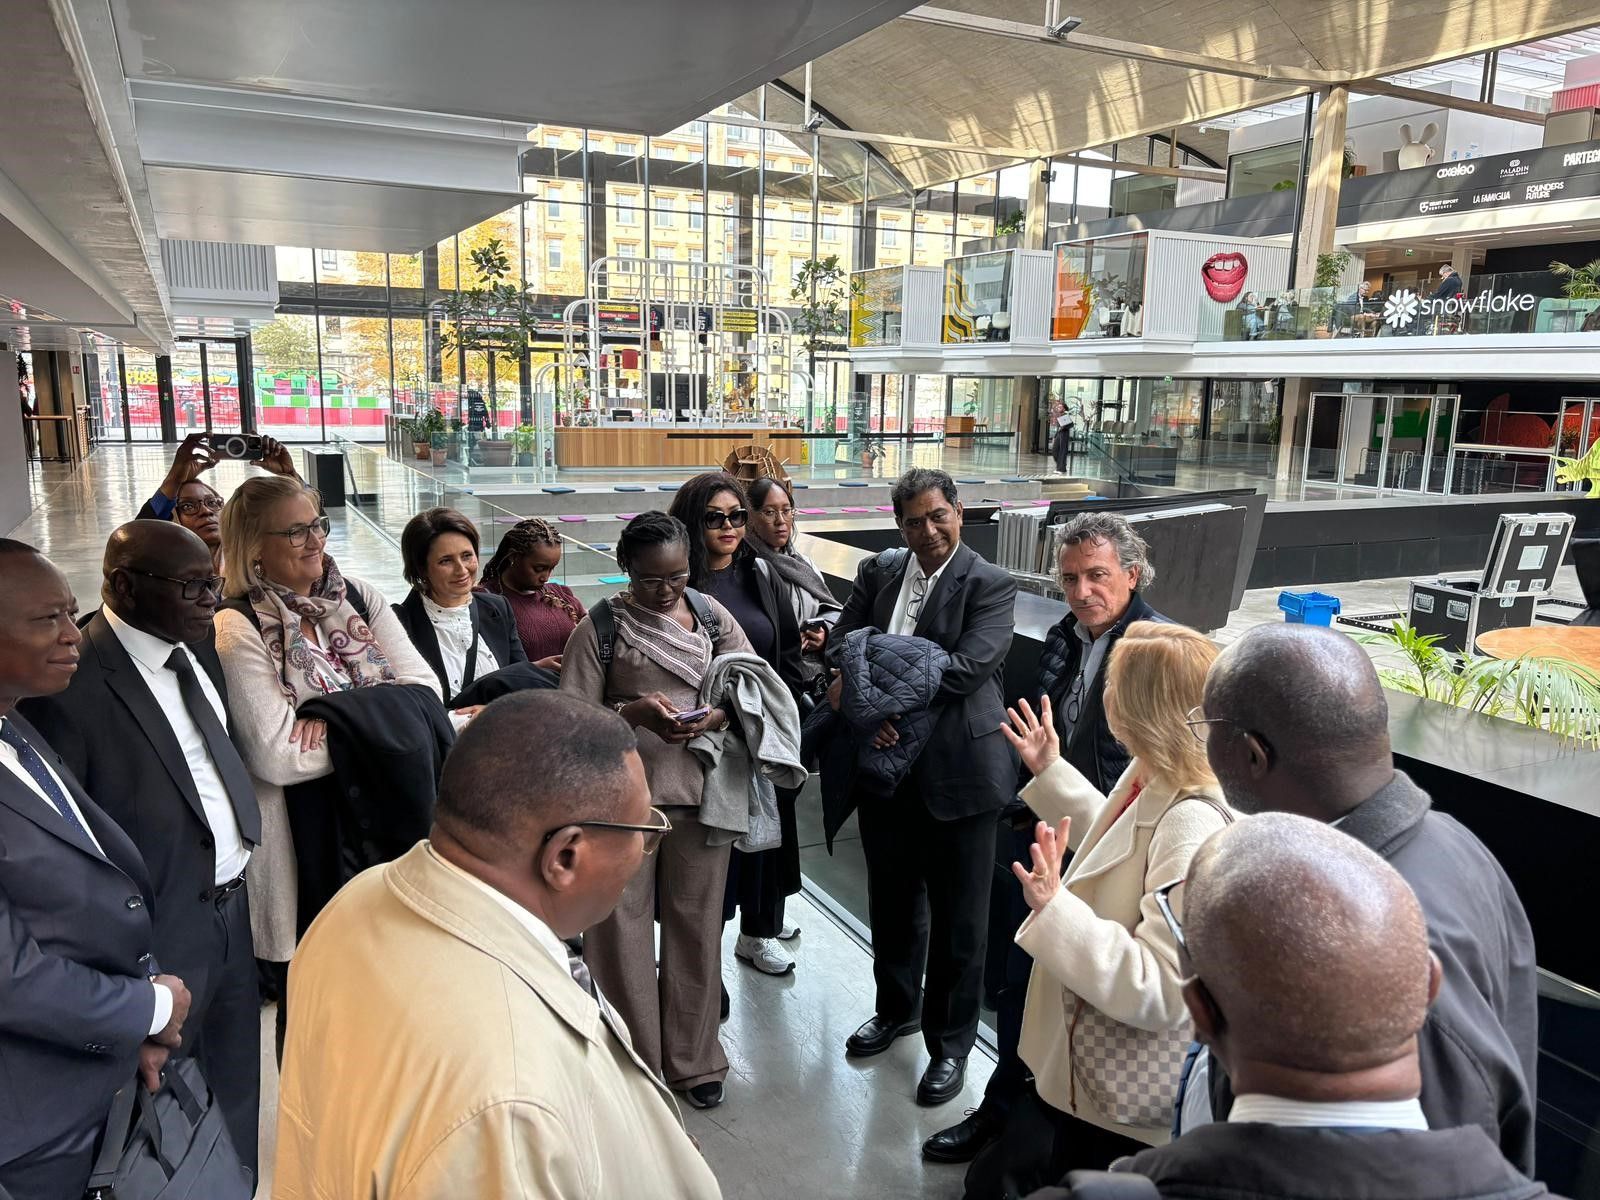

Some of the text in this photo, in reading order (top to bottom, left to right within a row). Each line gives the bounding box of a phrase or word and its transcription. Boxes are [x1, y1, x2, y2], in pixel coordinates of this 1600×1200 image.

[1437, 163, 1475, 179] axeleo
[1500, 165, 1529, 175] PALADIN
[1526, 182, 1565, 193] FOUNDERS
[1473, 191, 1511, 204] LA FAMIGLIA
[1526, 190, 1551, 200] FUTURE
[1420, 288, 1535, 315] snowflake
